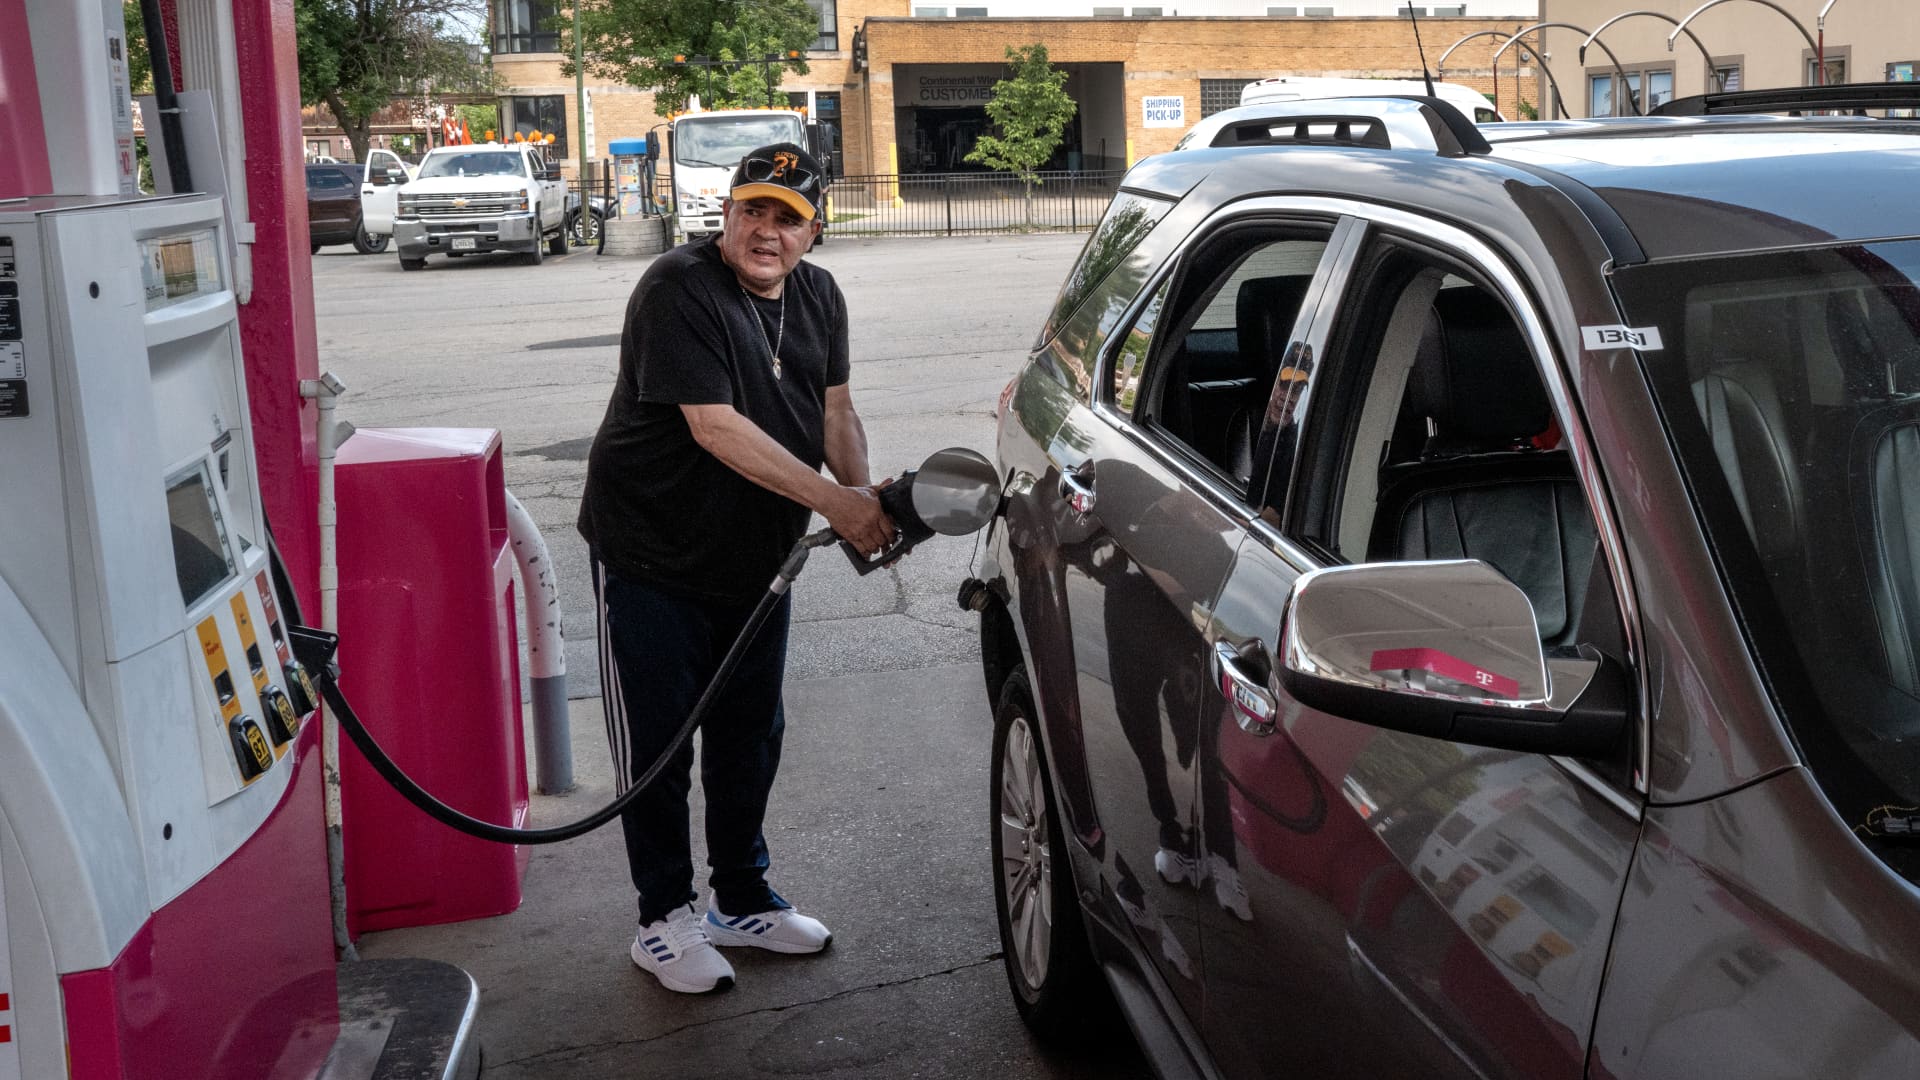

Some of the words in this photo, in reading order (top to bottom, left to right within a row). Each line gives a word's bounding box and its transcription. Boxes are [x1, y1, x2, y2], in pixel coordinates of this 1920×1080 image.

[920, 76, 975, 85] Continental
[1145, 98, 1181, 108] SHIPPING
[1146, 109, 1181, 121] PICK-UP
[1596, 329, 1647, 346] 1361
[252, 736, 266, 760] 87
